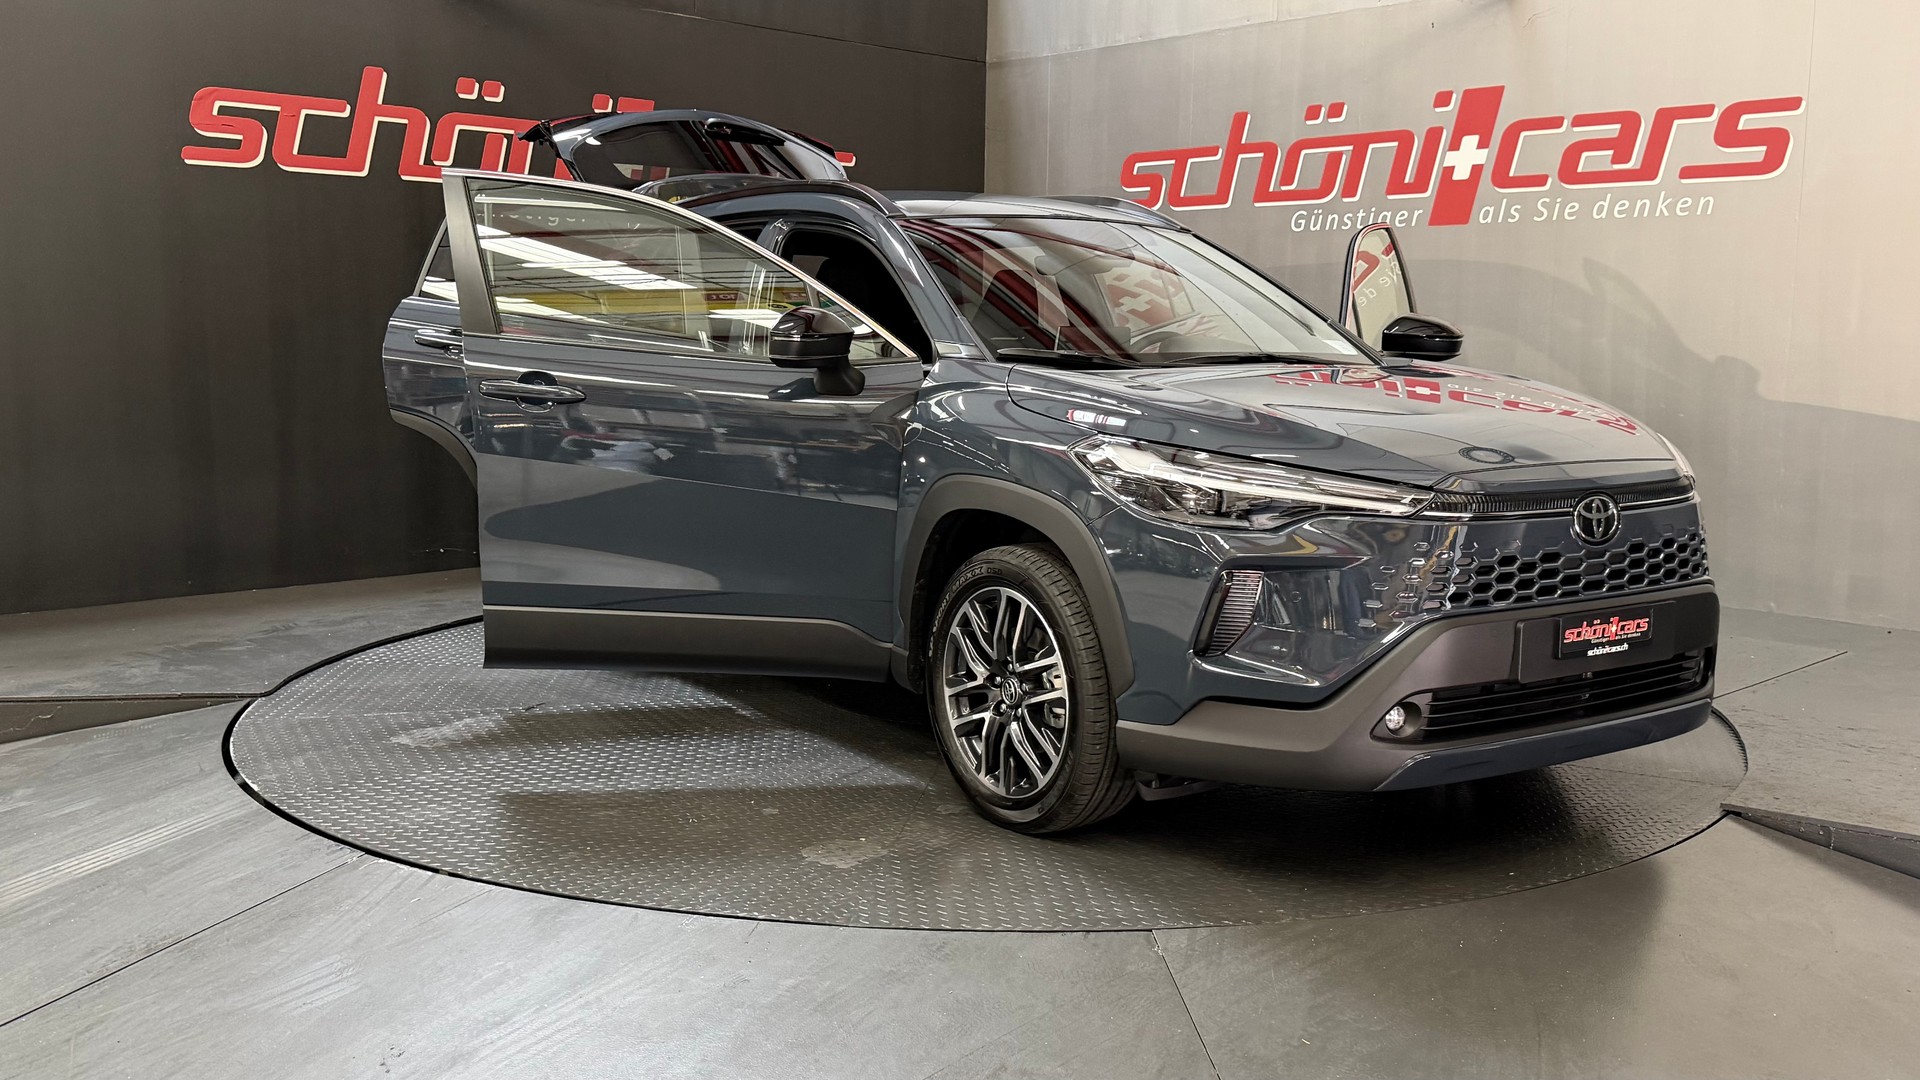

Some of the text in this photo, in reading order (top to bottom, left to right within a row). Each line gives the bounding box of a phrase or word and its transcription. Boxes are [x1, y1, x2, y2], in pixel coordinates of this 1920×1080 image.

[1479, 199, 1521, 224] als
[1533, 197, 1579, 222] Sie
[1592, 191, 1715, 219] denken
